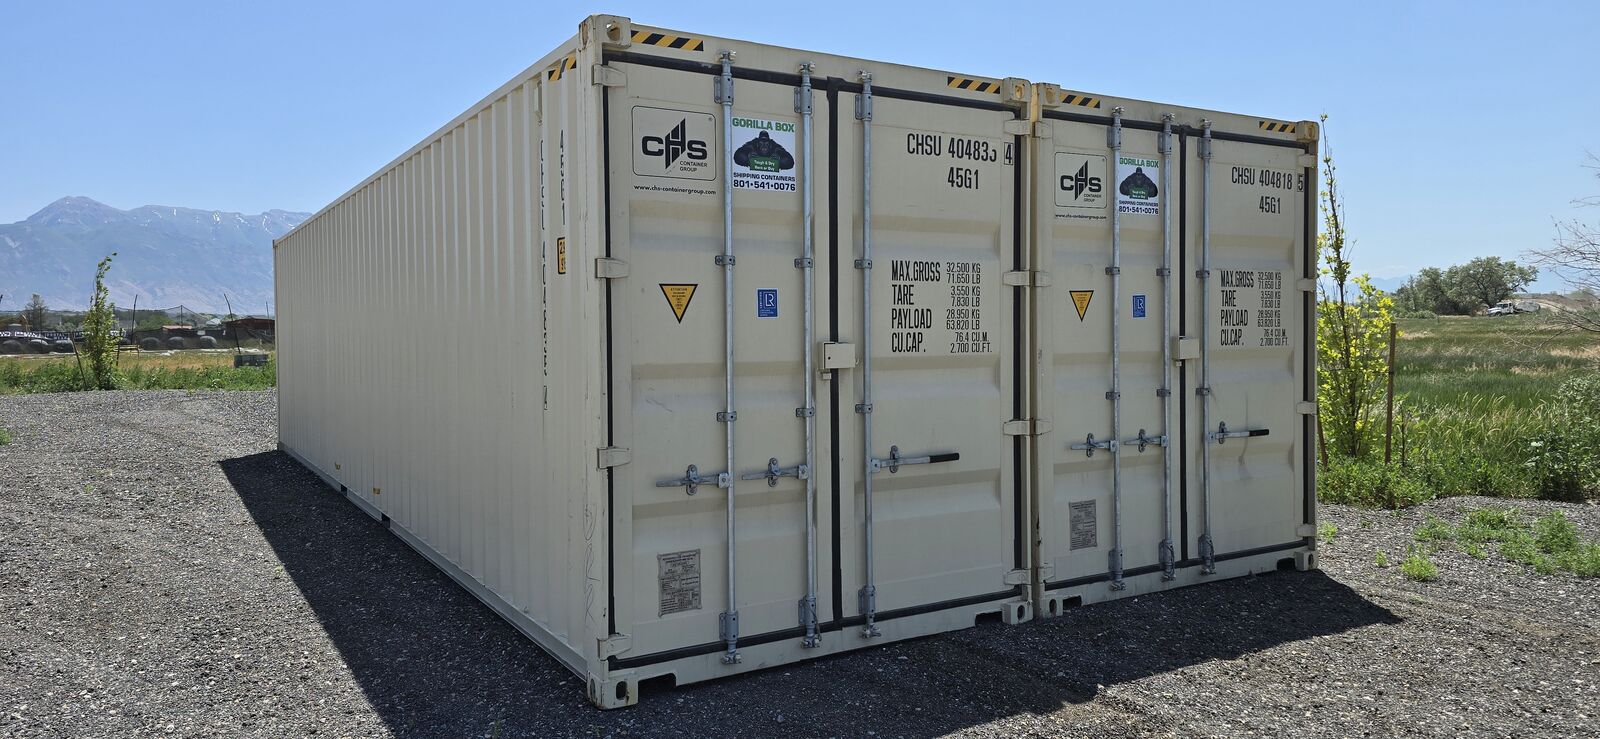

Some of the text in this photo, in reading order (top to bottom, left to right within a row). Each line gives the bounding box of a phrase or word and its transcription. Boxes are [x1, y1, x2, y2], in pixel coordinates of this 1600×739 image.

[732, 118, 795, 132] GORILLA BOX
[642, 118, 708, 170] CHS
[907, 133, 942, 156] CHSU
[1005, 143, 1012, 164] 4
[1120, 158, 1159, 168] GORILLA BOX
[948, 166, 978, 190] 45G1
[1060, 160, 1102, 201] CHS
[1232, 166, 1304, 191] CHSU 404818 5
[634, 185, 716, 195] www.chs-containergroup.com
[1259, 195, 1281, 214] 45G1
[892, 260, 941, 282] MAX.GROSS
[946, 262, 981, 274] 32.500 KG
[946, 273, 981, 284] 71.650 LB
[892, 284, 914, 305] TARE
[950, 285, 981, 296] 3.550 KG
[1221, 290, 1236, 307] TARE
[951, 296, 981, 307] 7.830 LB
[892, 308, 932, 329] PAYLOAD
[946, 309, 980, 319] 28.950 KG
[1220, 309, 1248, 326] PAYLOAD
[946, 320, 980, 330] 63.820 LB
[892, 332, 926, 353] CU.CAP.
[954, 332, 969, 342] 76.4
[950, 343, 969, 354] 2.700
